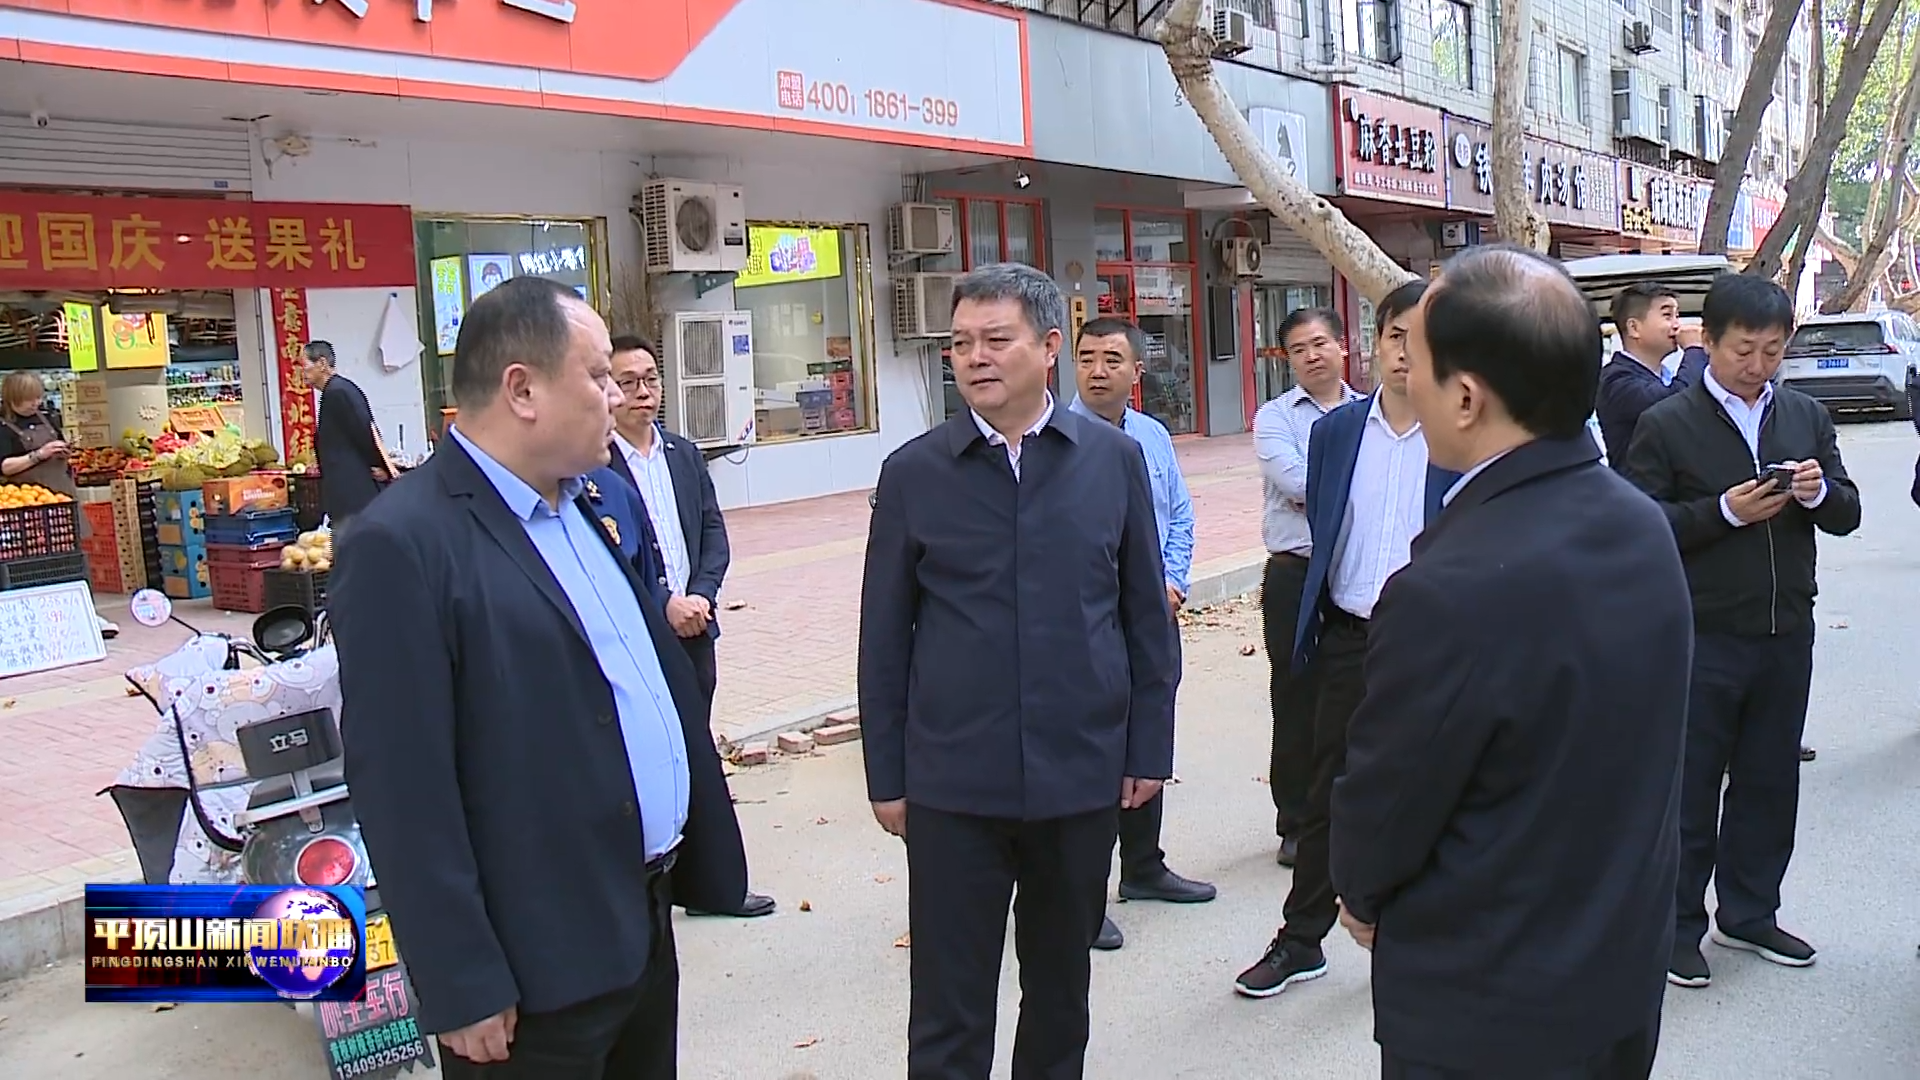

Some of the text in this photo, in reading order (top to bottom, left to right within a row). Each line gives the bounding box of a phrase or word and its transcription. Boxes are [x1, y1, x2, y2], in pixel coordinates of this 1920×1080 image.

[779, 73, 801, 90] 加盟
[780, 91, 803, 107] 电话
[865, 89, 958, 126] 1861-399
[206, 217, 366, 271] 送果礼
[269, 728, 309, 753] 立马
[336, 1040, 424, 1080] 13409325256
